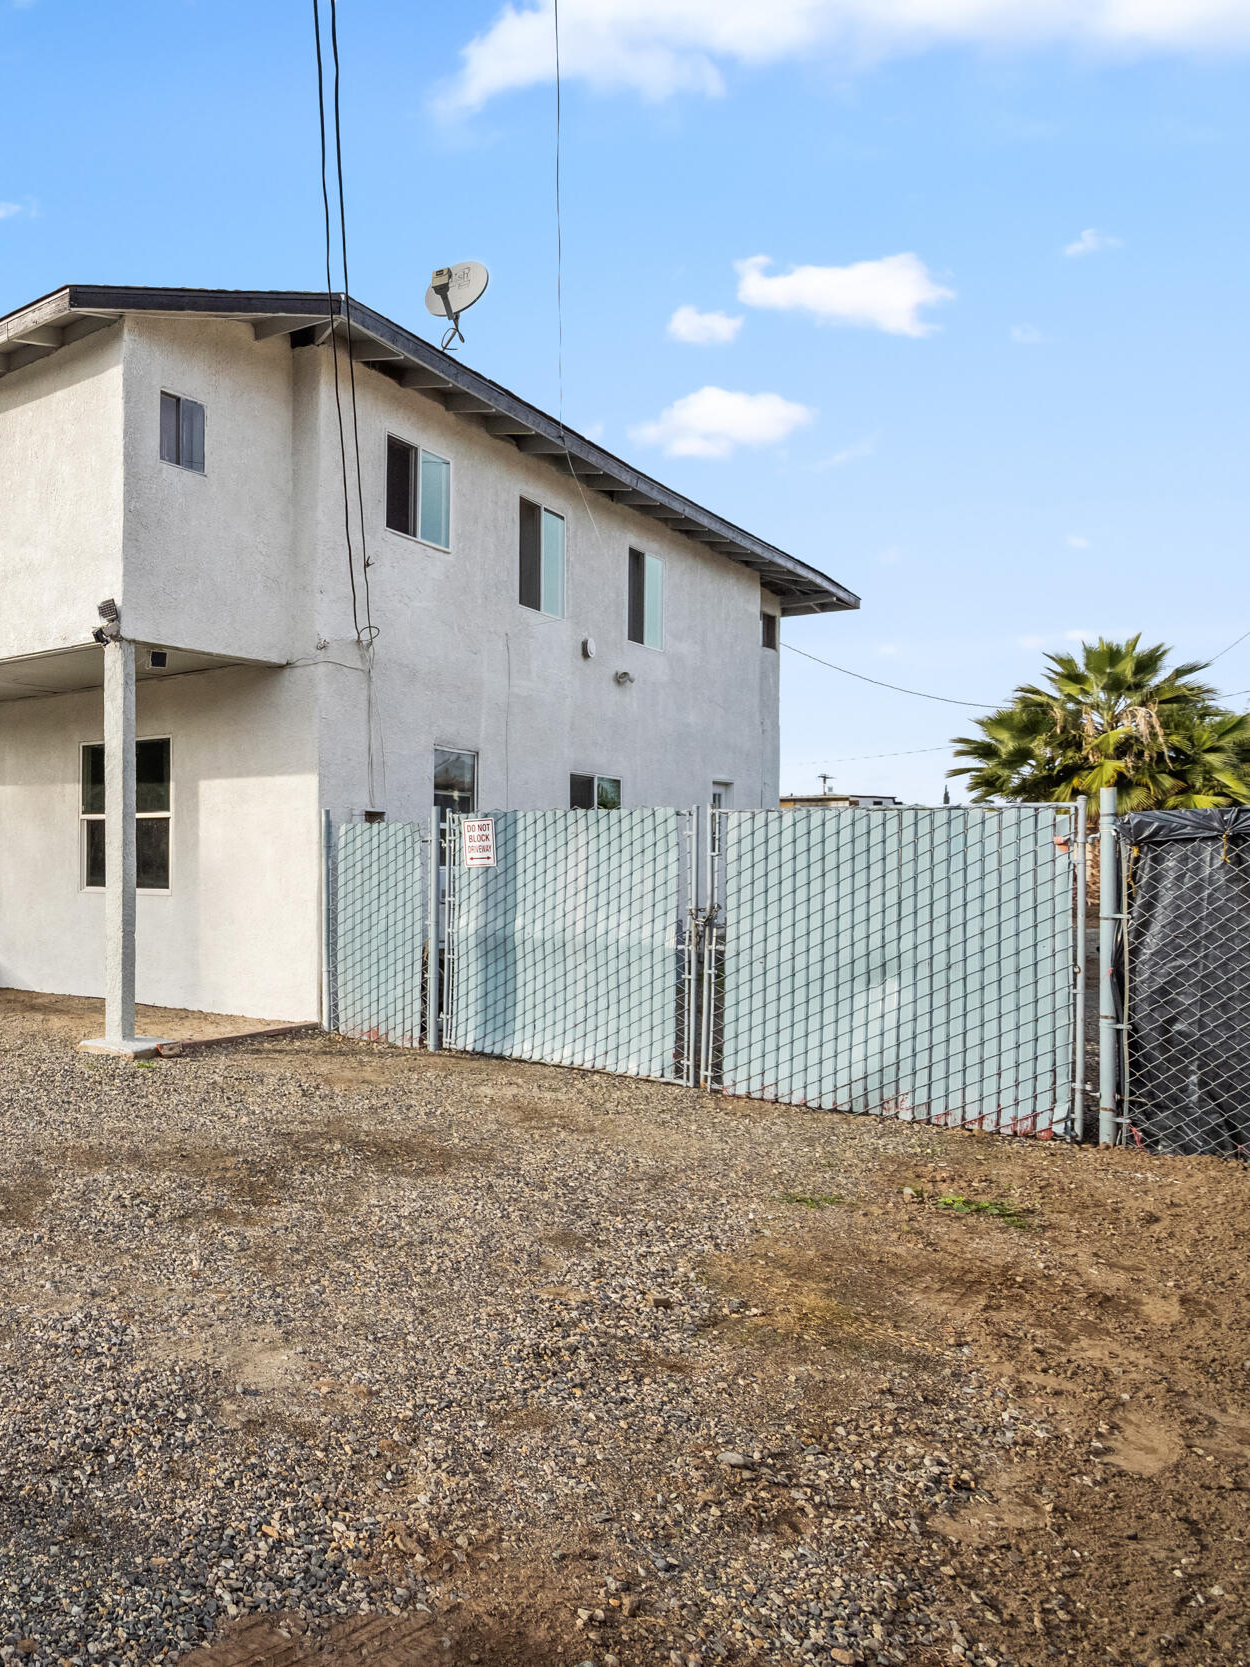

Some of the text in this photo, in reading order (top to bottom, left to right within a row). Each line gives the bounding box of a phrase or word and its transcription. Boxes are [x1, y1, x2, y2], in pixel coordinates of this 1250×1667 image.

[467, 823, 490, 833] DO NOT
[468, 833, 490, 843] BLOCK
[467, 844, 492, 854] DRIVEWAY
